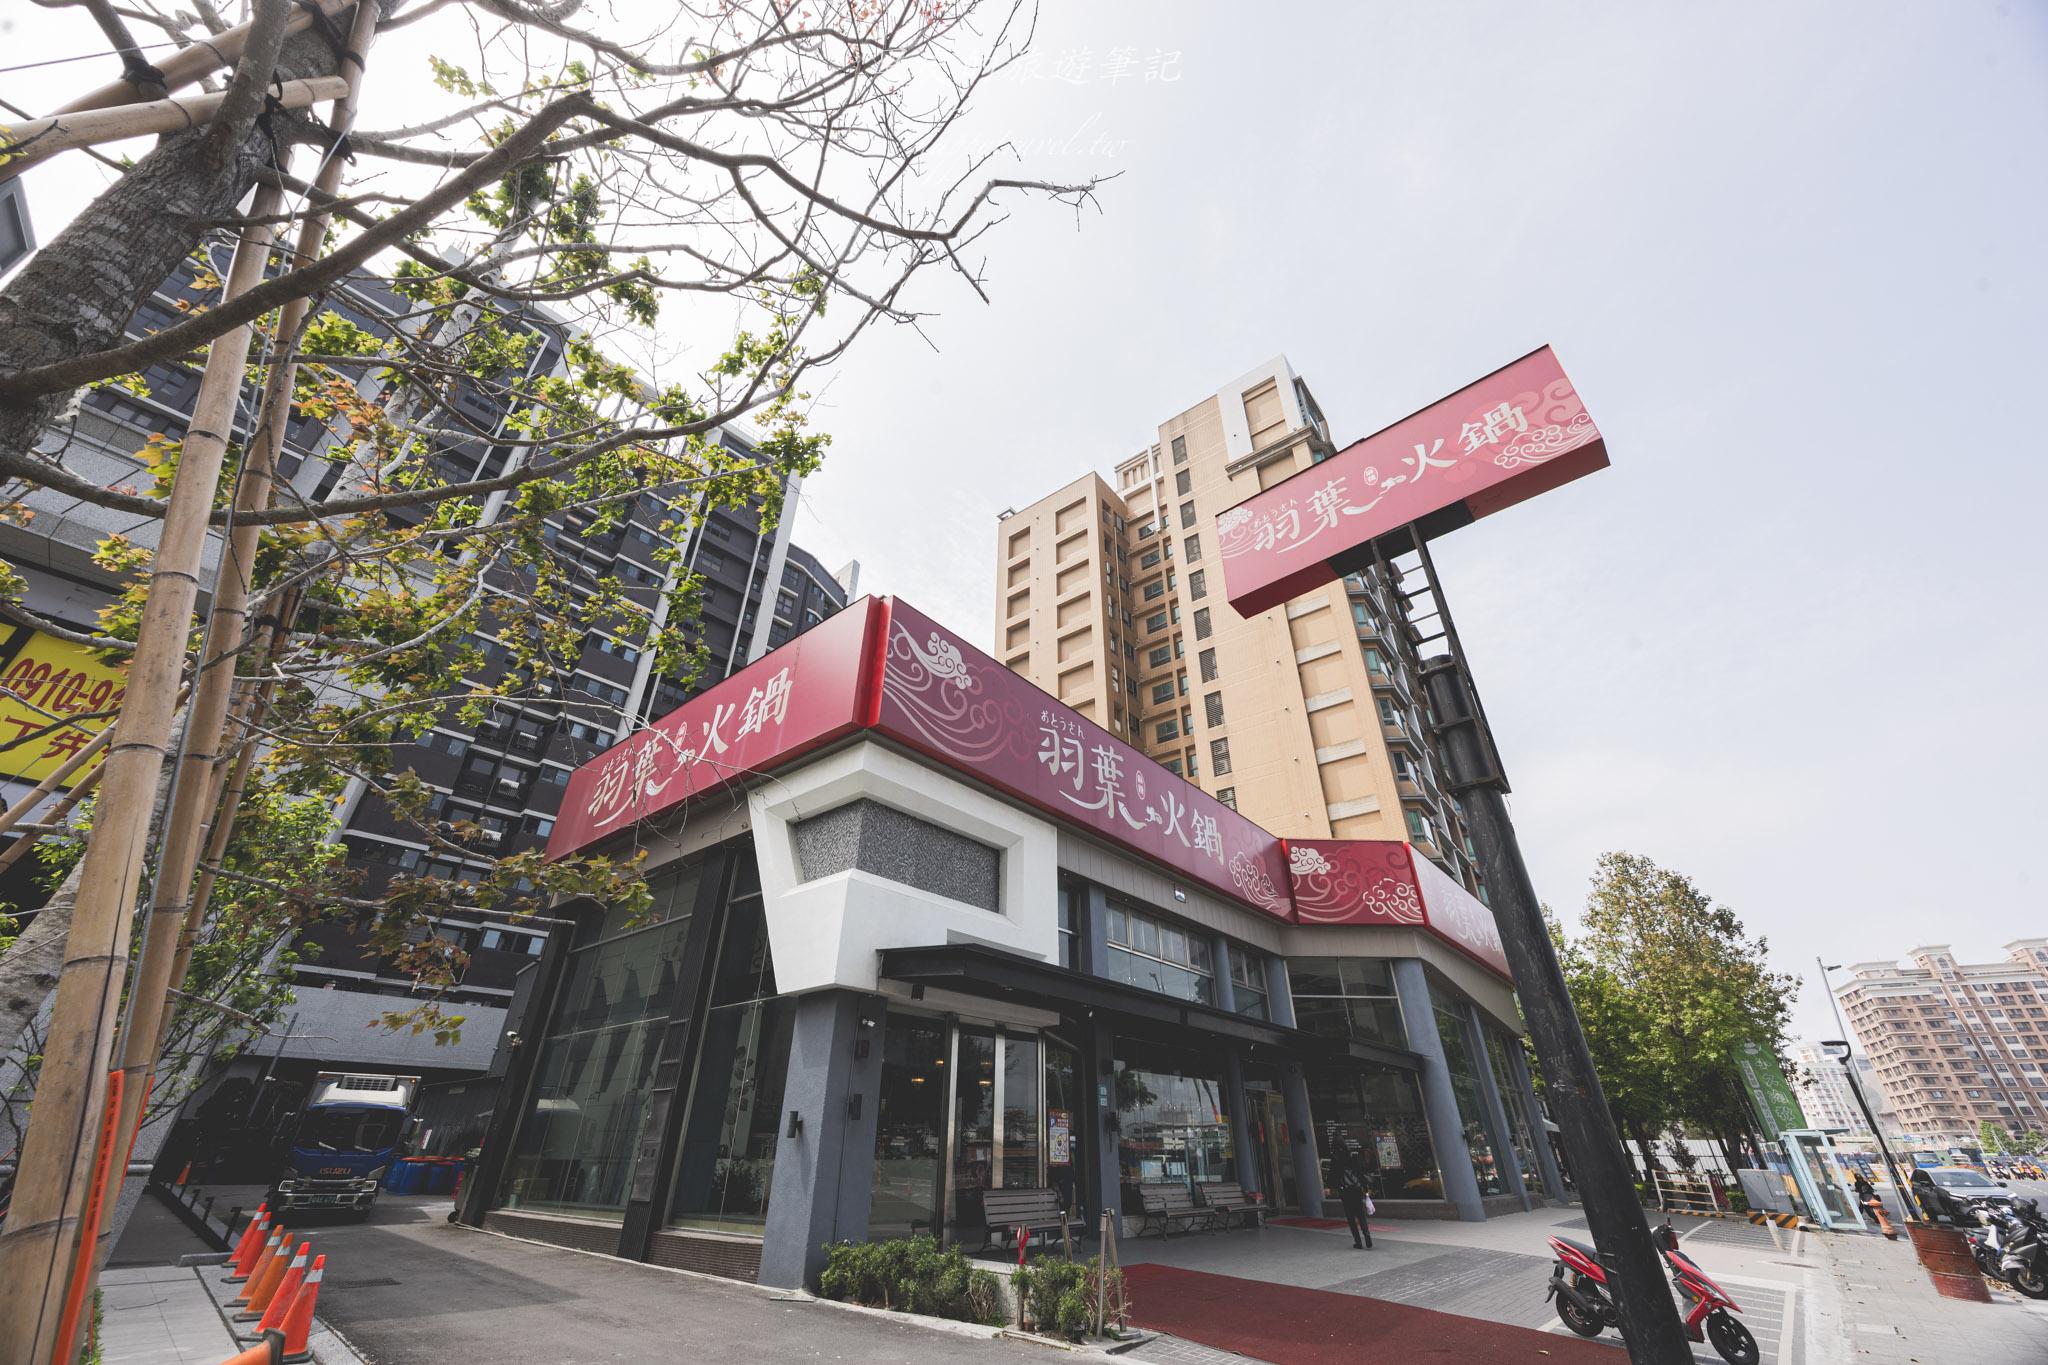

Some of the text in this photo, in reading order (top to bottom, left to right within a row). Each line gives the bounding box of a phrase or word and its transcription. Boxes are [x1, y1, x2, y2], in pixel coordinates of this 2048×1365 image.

[1040, 709, 1086, 740] おとうさん
[319, 1167, 353, 1176] ISUZU
